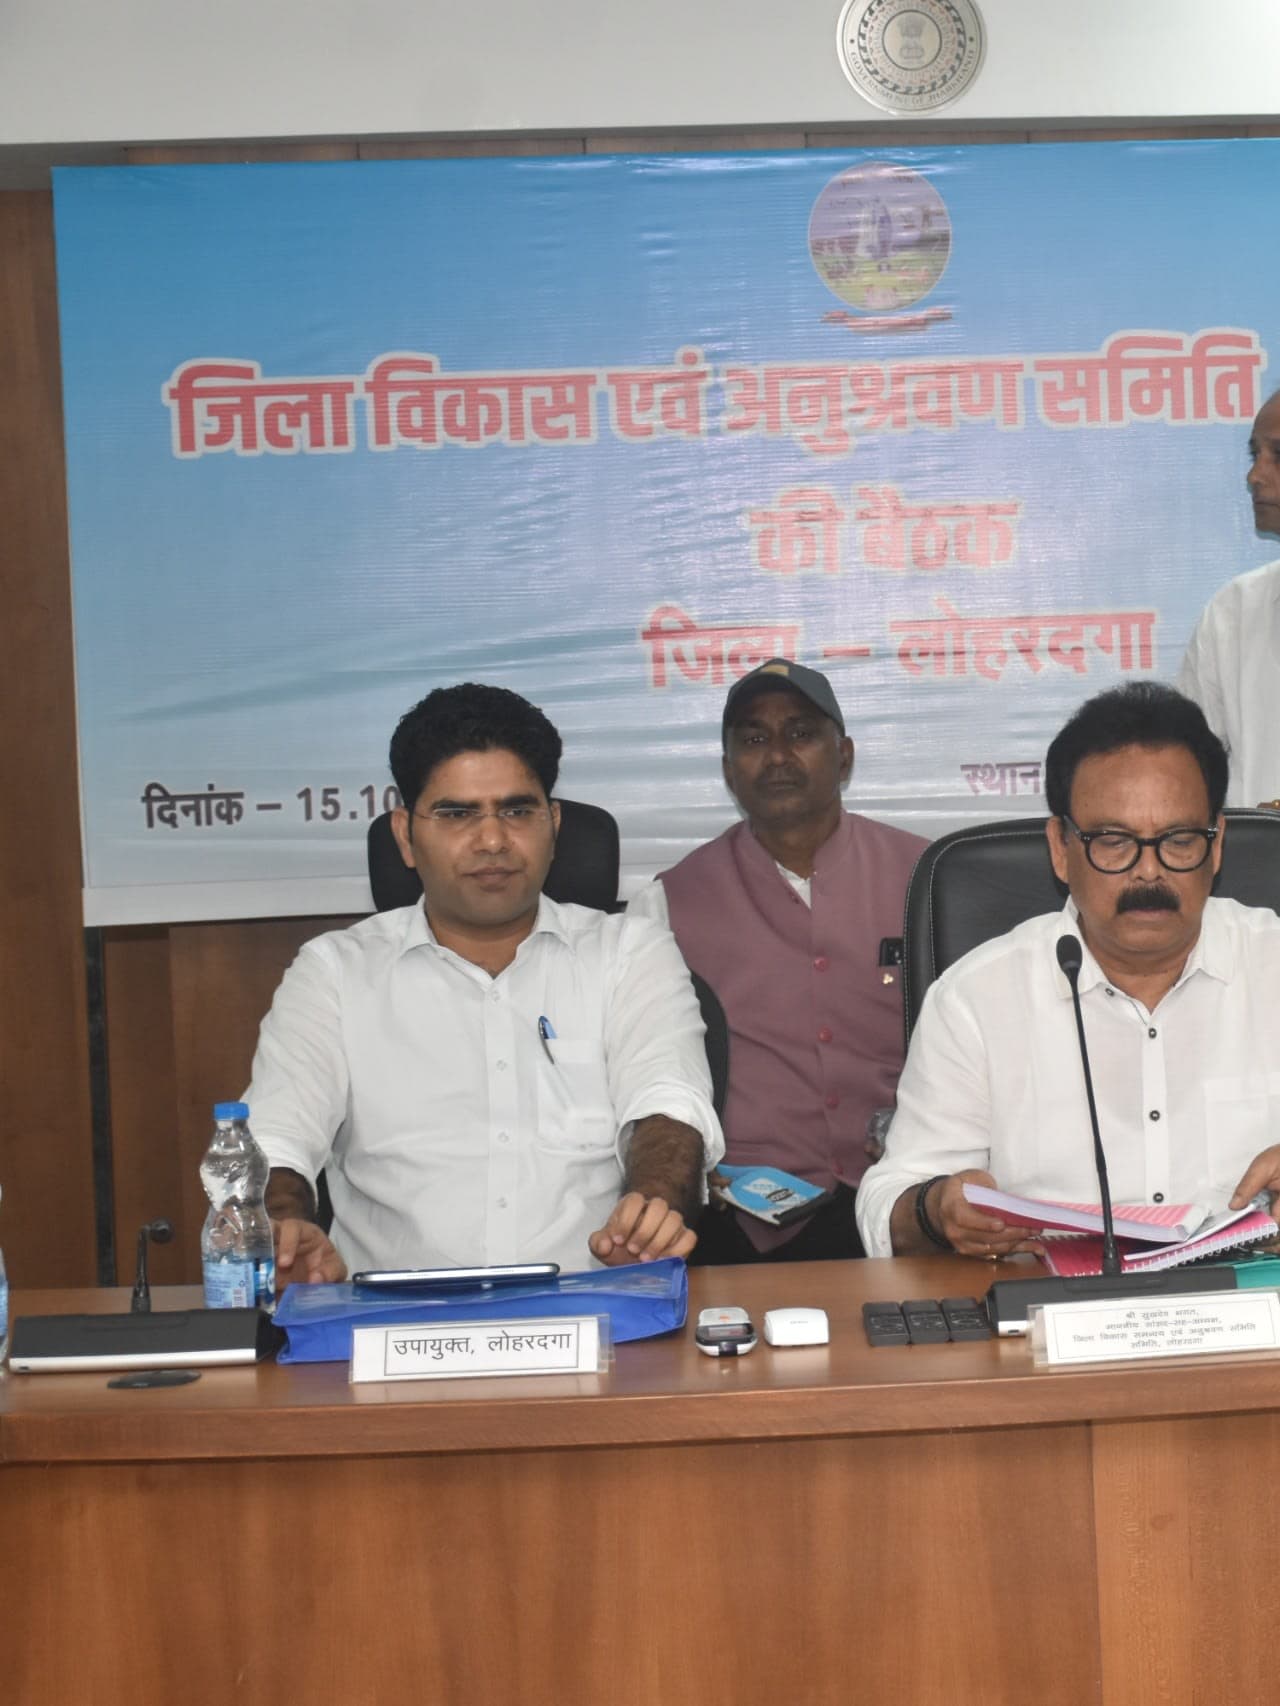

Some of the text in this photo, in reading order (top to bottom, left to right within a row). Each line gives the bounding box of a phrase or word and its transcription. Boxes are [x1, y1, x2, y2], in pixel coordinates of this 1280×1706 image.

[168, 363, 355, 453] जिला
[365, 358, 597, 446] विकास
[606, 351, 708, 437] एवं
[724, 360, 1025, 455] अनुश्रवण
[1034, 334, 1262, 424] समिति
[750, 486, 1018, 573] की बैठक
[641, 605, 800, 687] जिला
[889, 597, 1155, 681] लोहरदगा
[141, 782, 244, 828] दिनांक
[959, 761, 1042, 796] स्थान
[392, 1330, 572, 1360] उपायुक्त, लोहरदगा
